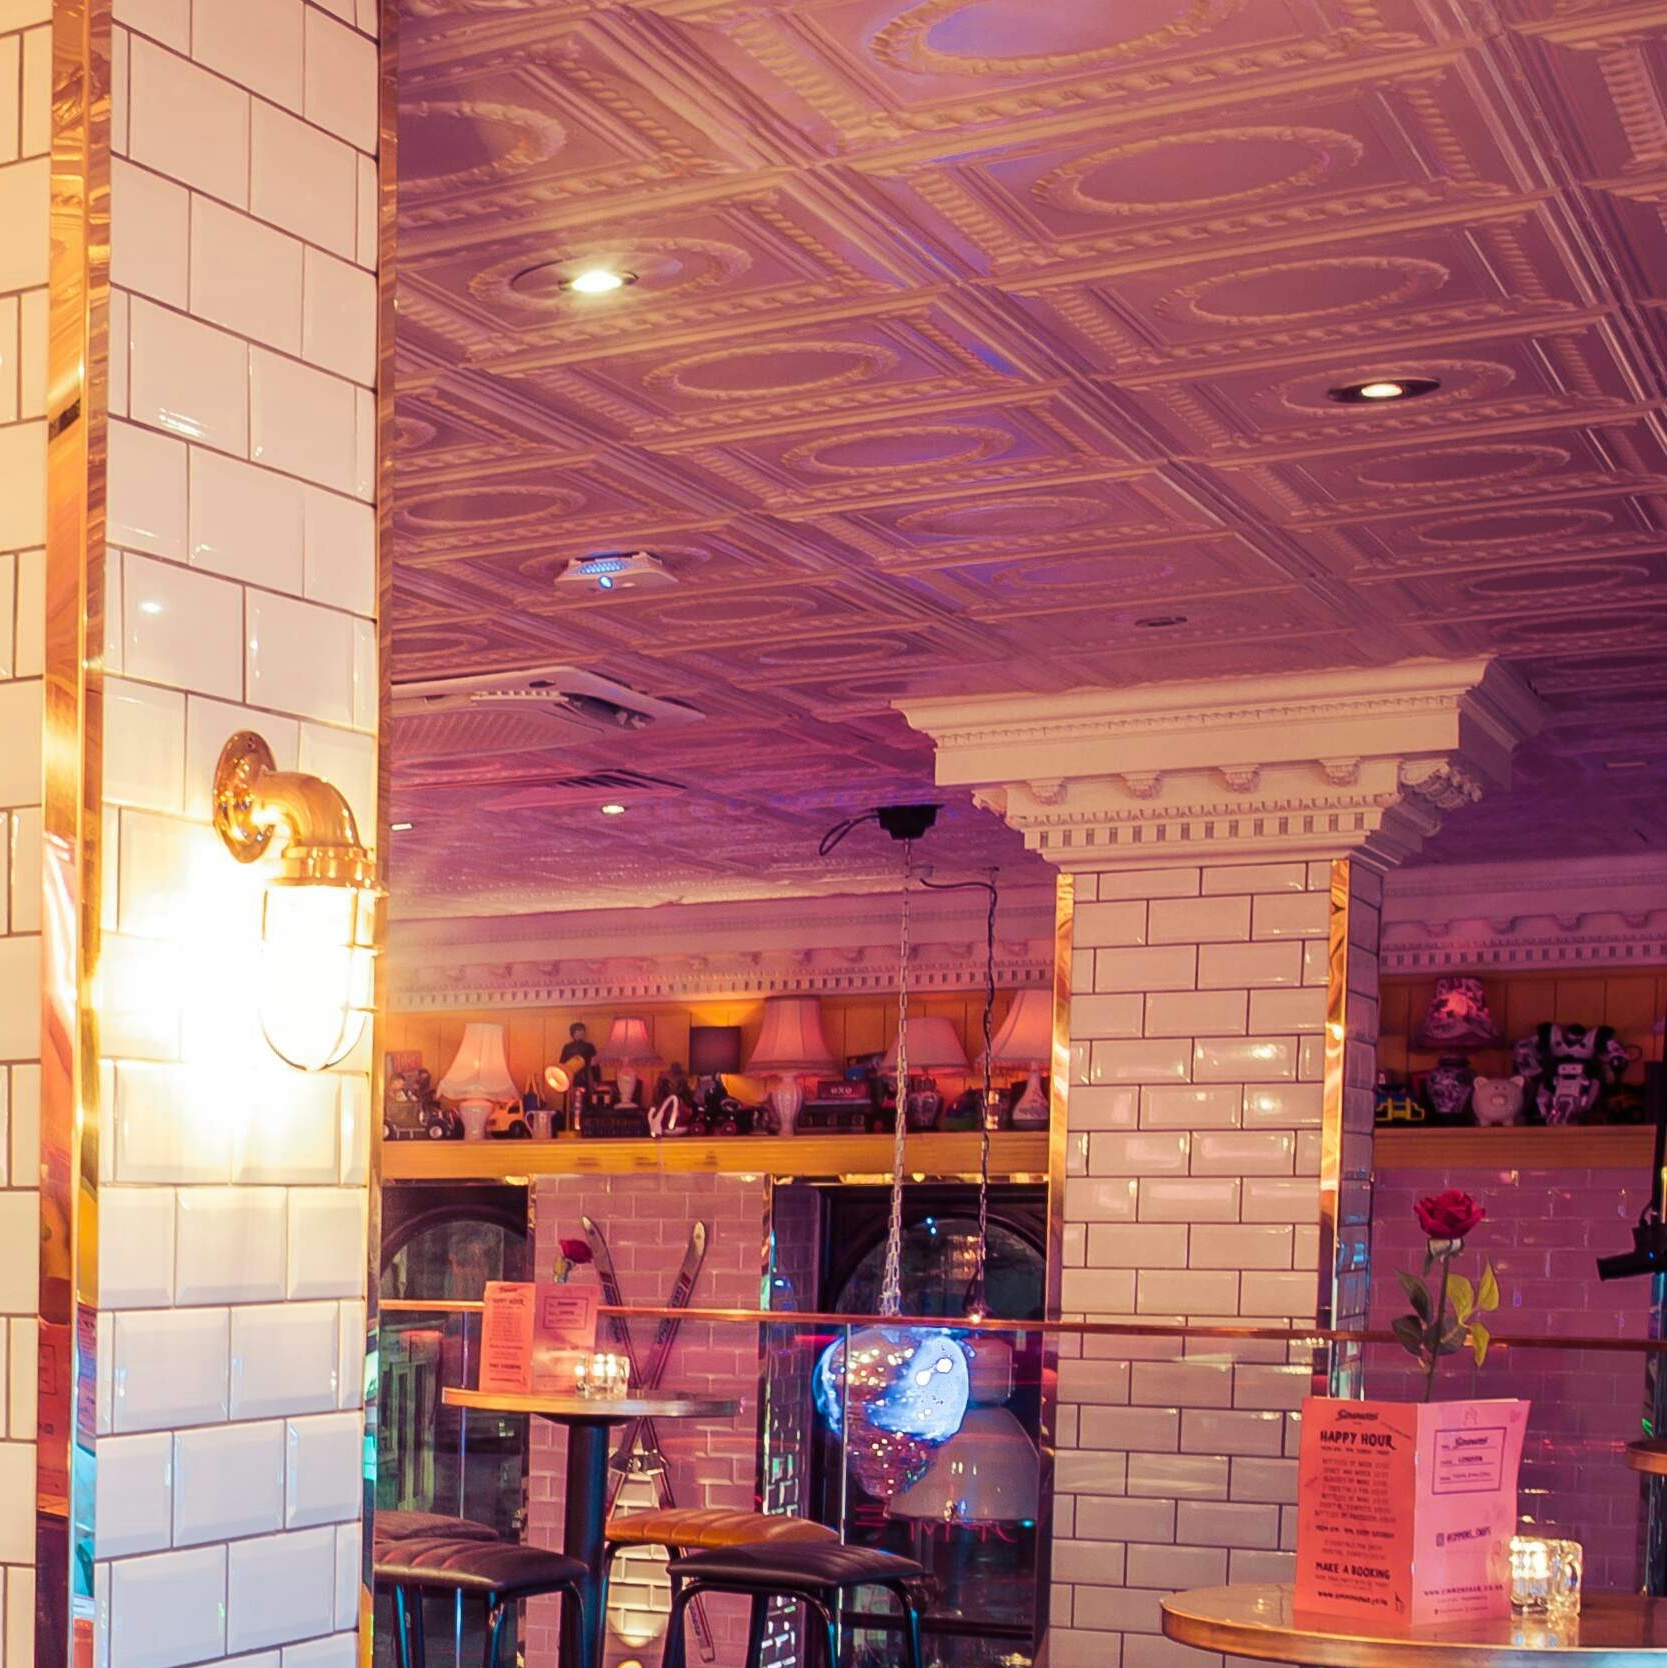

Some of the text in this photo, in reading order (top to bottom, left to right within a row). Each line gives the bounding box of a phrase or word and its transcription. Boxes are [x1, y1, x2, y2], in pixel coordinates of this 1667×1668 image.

[1320, 1430, 1357, 1445] HAPPY
[1360, 1432, 1397, 1451] HOUR
[1315, 1561, 1391, 1580] MAKE A BOOKING
